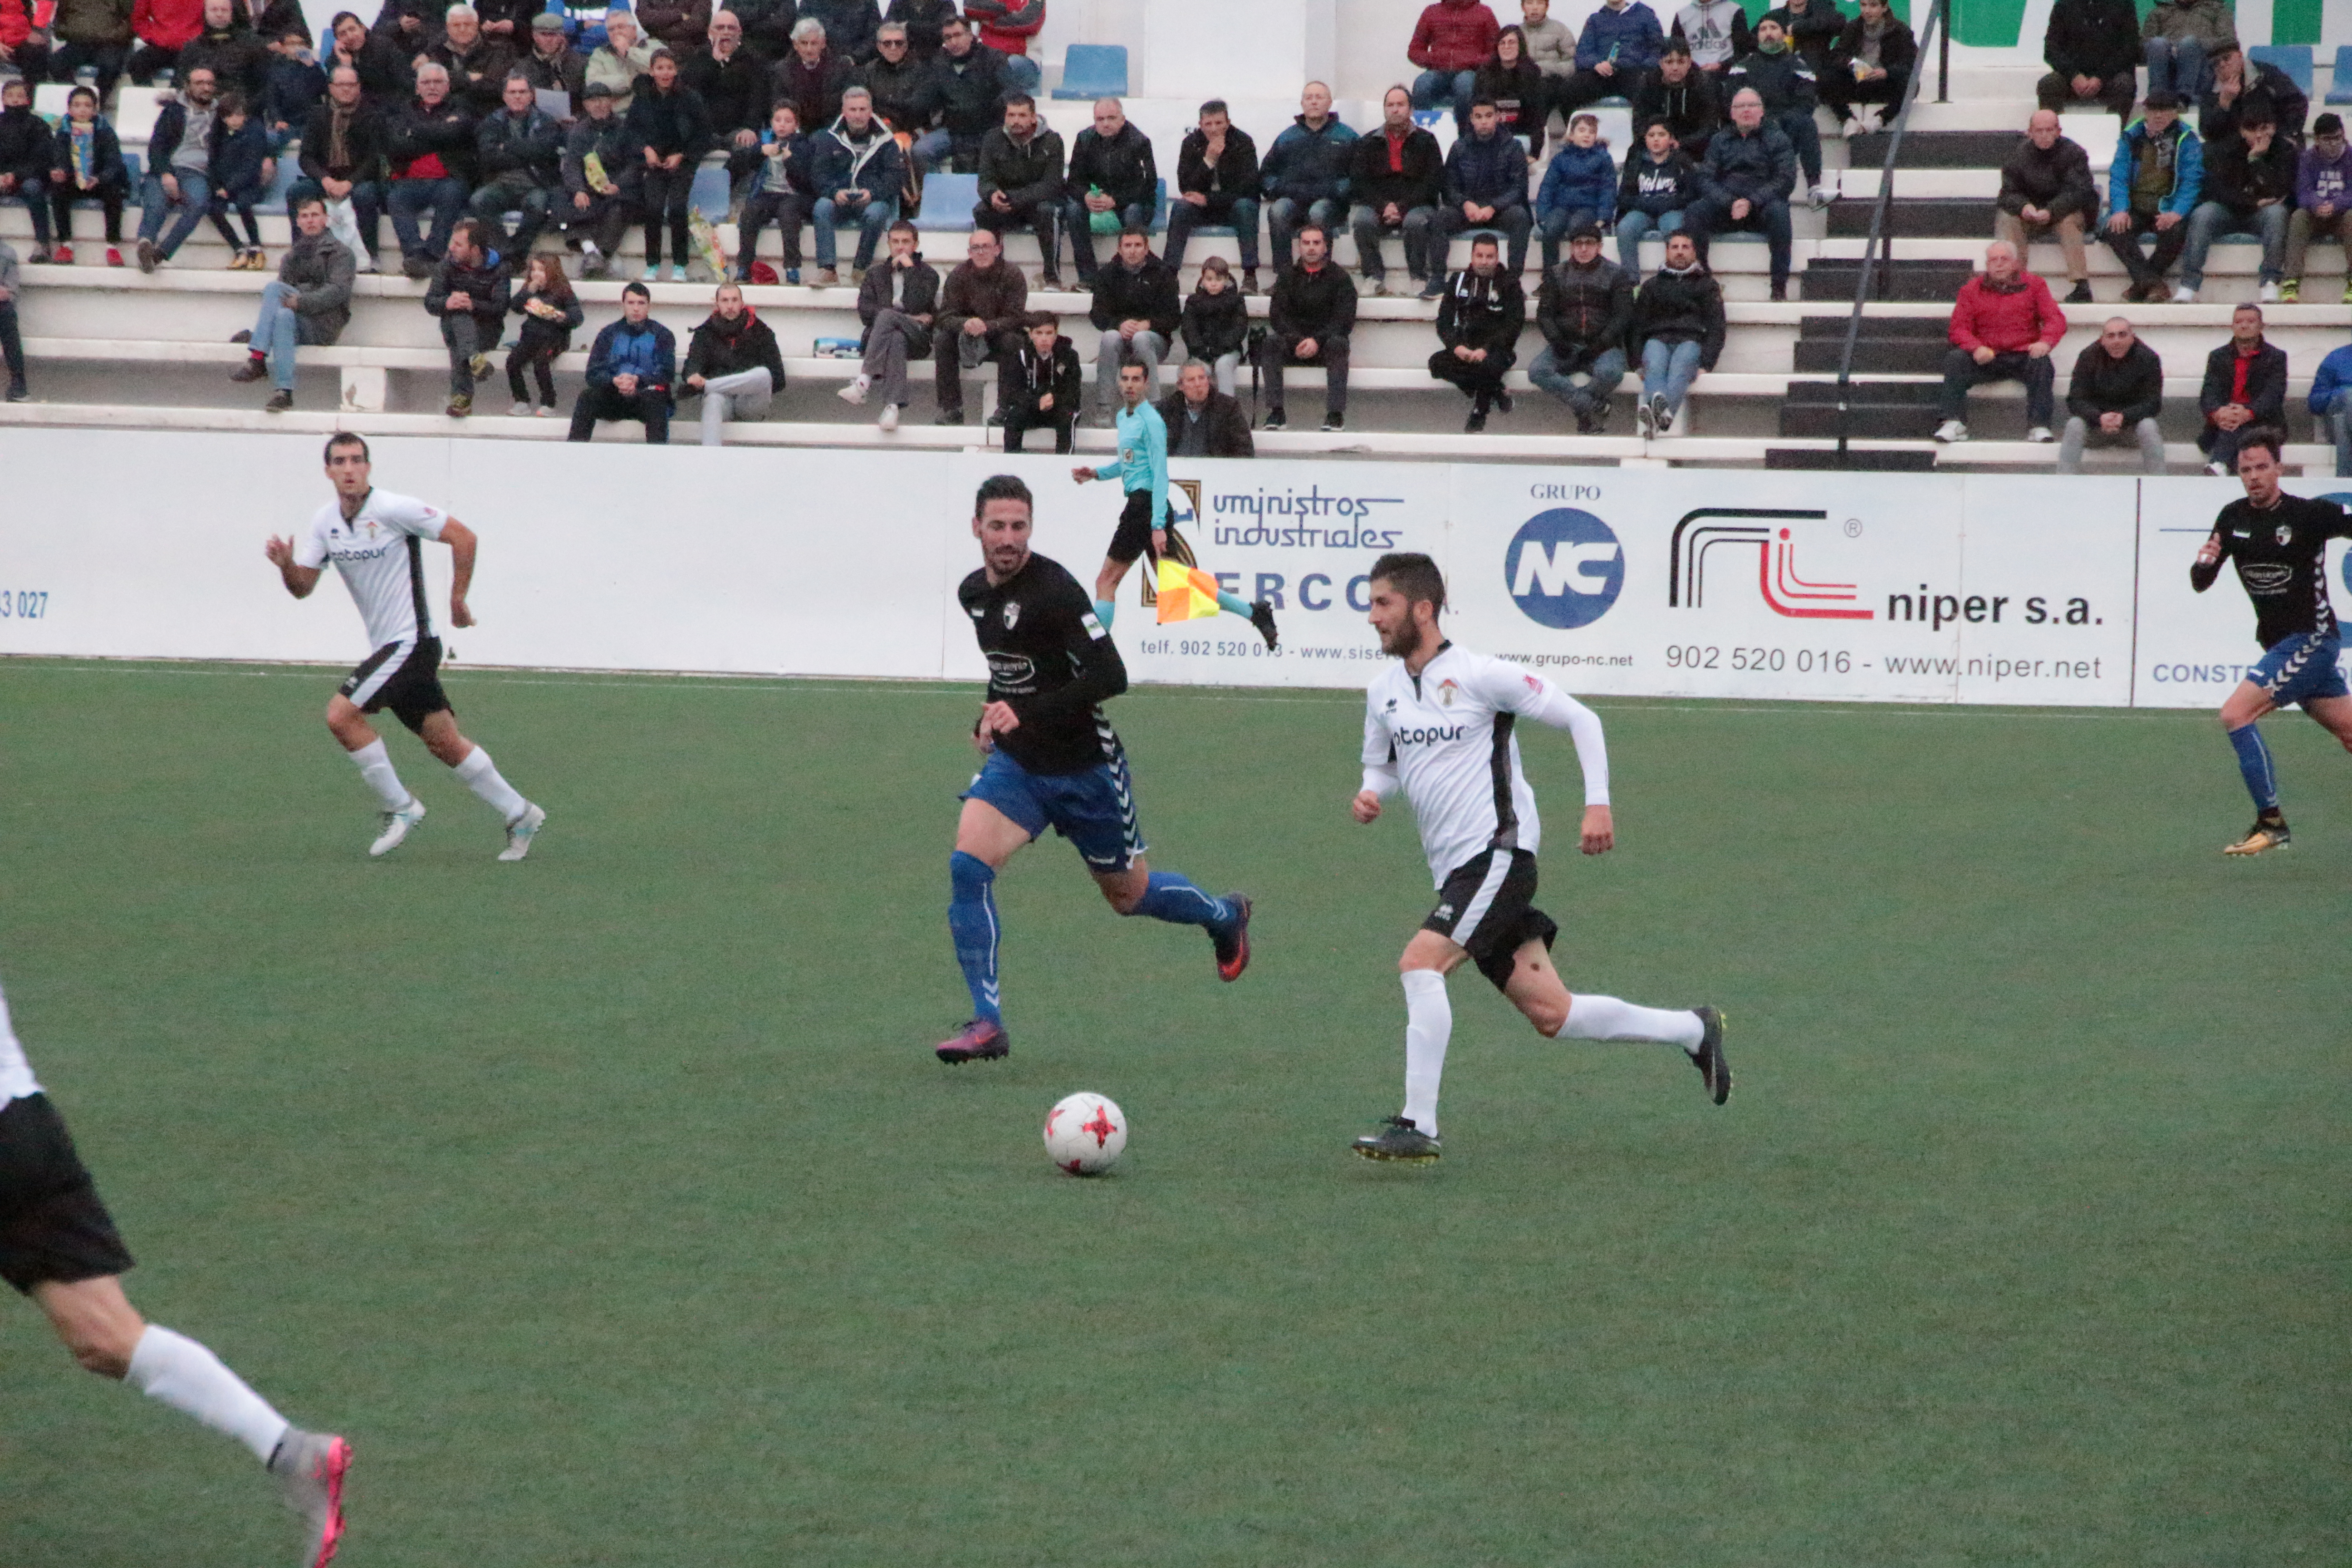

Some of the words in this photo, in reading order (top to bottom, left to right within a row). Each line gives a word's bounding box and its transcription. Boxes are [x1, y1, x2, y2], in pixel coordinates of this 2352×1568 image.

[1531, 484, 1601, 500] GRUPO
[1215, 519, 1403, 548] industriales
[1512, 541, 1618, 597] NC
[0, 590, 11, 617] 3
[18, 591, 48, 618] 027
[1888, 583, 2009, 631] niper
[2025, 595, 2102, 625] s.a.
[1142, 640, 1174, 654] telf.
[1181, 641, 1210, 655] 902
[1217, 642, 1247, 657] 520
[1667, 645, 1720, 669] 902
[1732, 647, 1784, 671] 520
[1797, 649, 1850, 673] 016
[1885, 653, 2102, 682] www.niper.net
